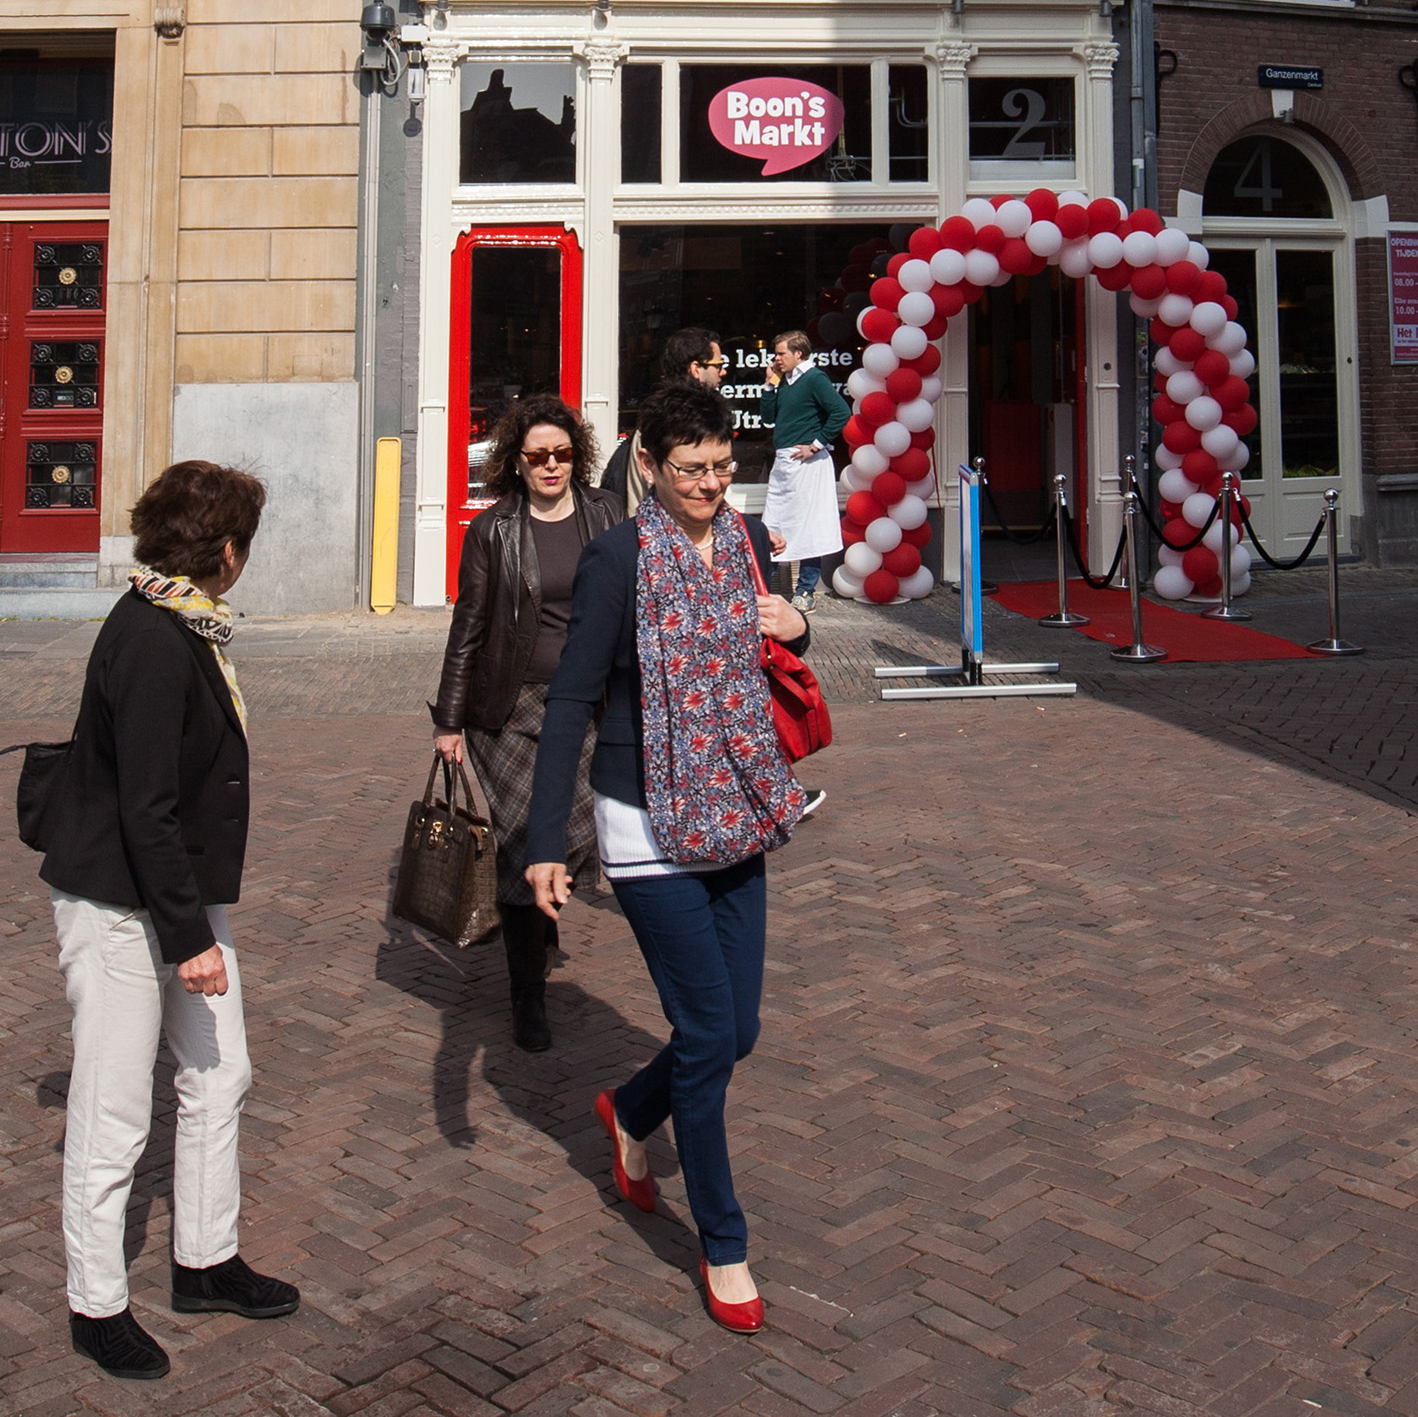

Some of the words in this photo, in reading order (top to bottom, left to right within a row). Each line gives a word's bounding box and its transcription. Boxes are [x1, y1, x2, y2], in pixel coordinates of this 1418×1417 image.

[1265, 68, 1319, 80] Ganzenmarkt
[727, 91, 825, 118] Boon's
[1002, 88, 1046, 156] 2
[734, 118, 825, 146] Markt
[9, 157, 32, 169] Bar
[1234, 142, 1282, 211] 4
[1395, 278, 1414, 286] 08.00
[1397, 327, 1412, 338] Het
[736, 349, 853, 368] lekrste
